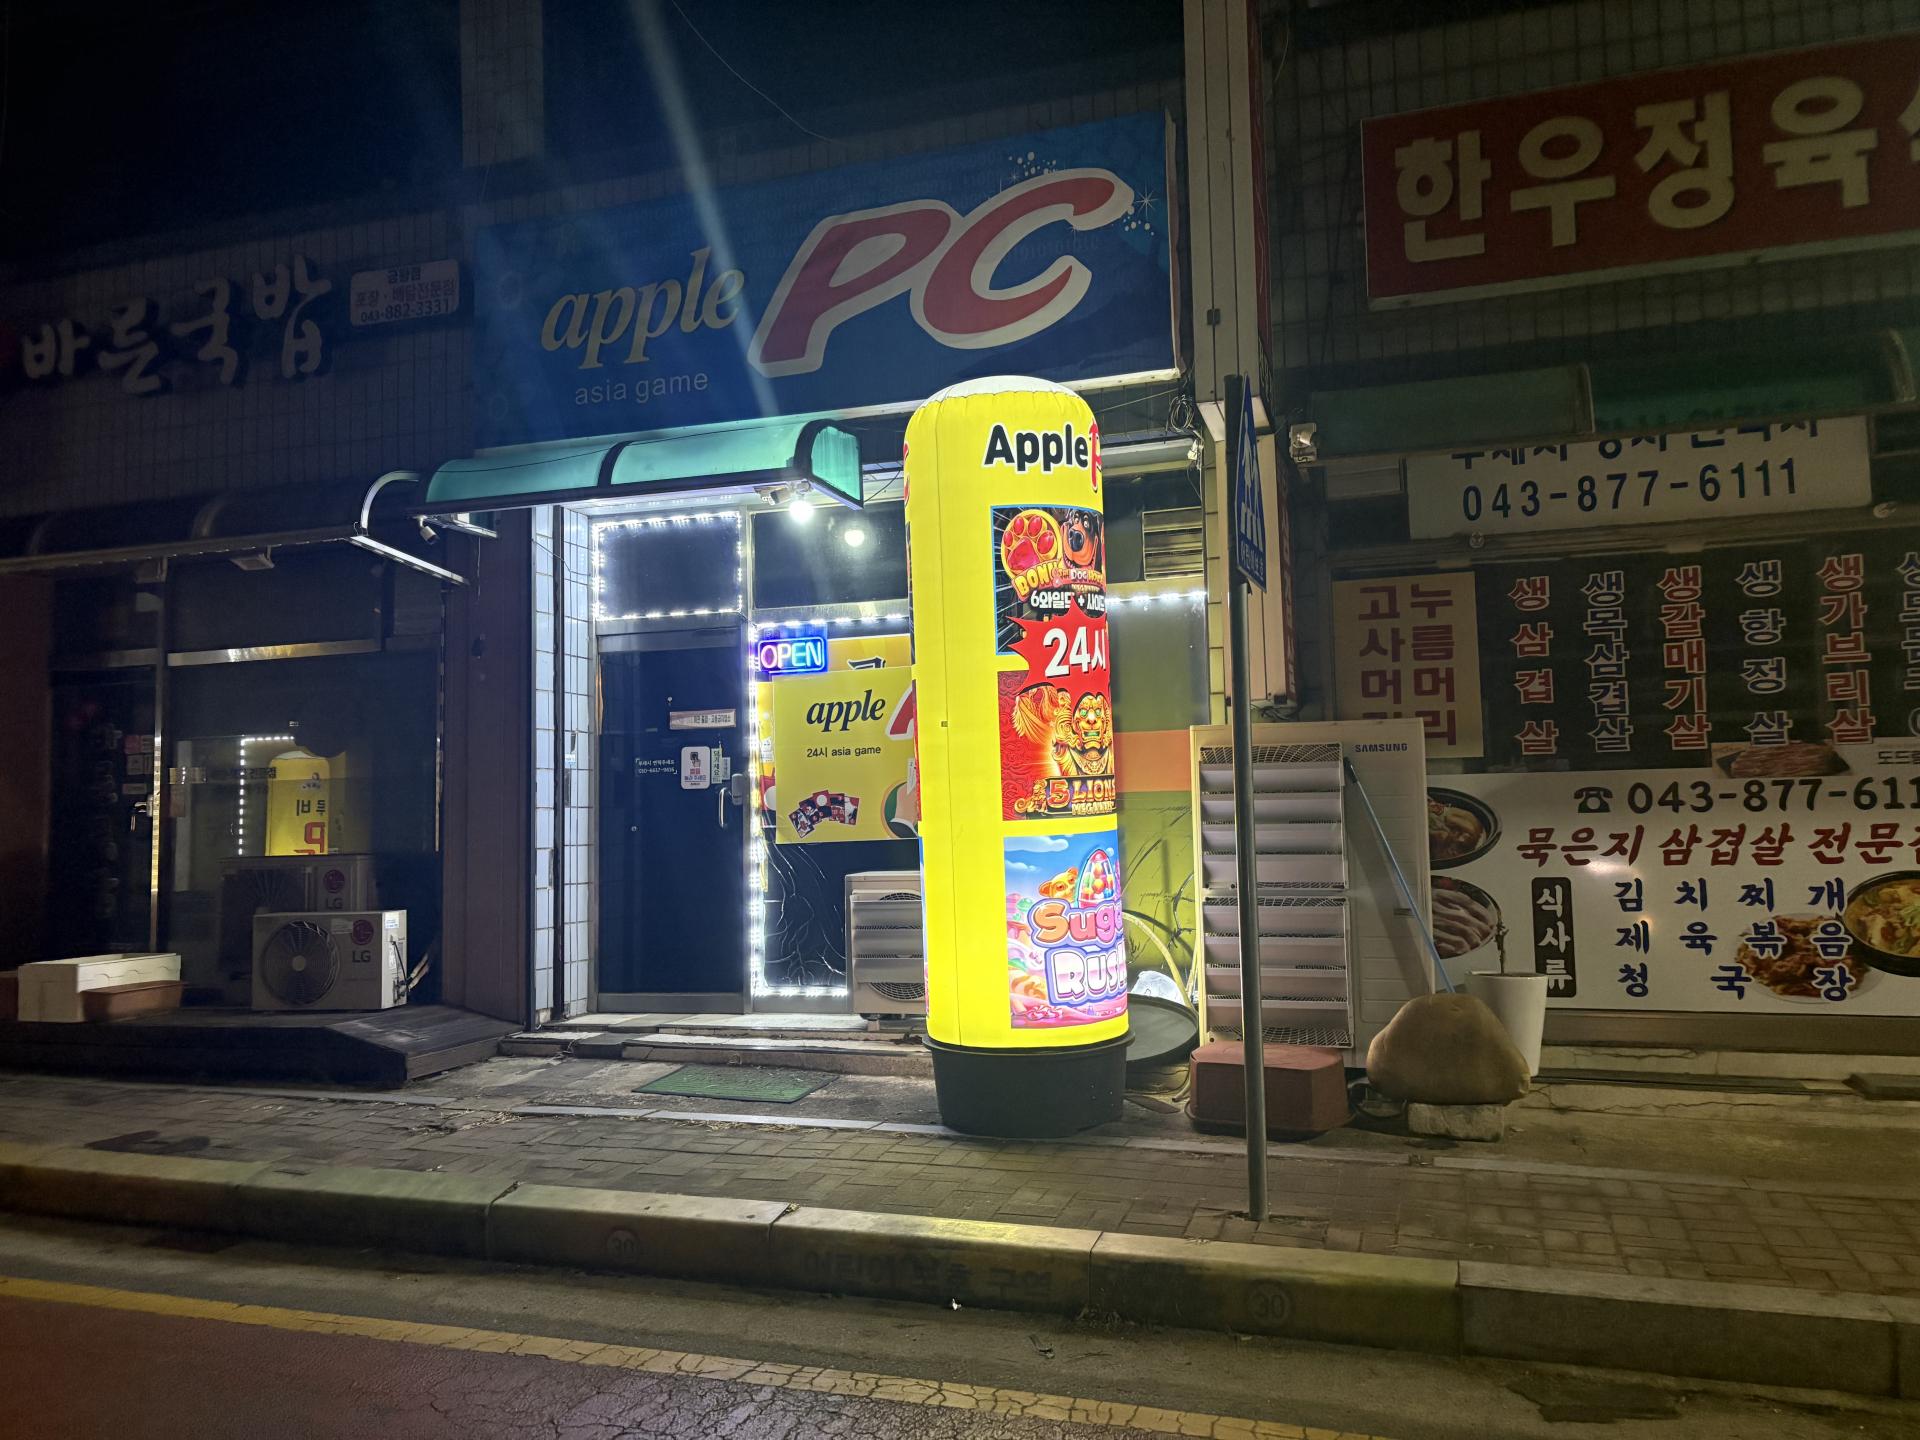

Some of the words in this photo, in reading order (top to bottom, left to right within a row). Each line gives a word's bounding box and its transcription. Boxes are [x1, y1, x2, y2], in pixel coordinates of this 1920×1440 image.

[541, 247, 745, 370] apple
[748, 167, 1135, 379] PC
[574, 378, 627, 407] asia
[635, 370, 709, 404] game
[984, 423, 1089, 472] Apple
[1462, 457, 1797, 522] 043-877-6111
[760, 641, 823, 670] OPEN
[1507, 576, 1560, 756] 생삼겹살
[1580, 571, 1636, 753] 생목삼겹살
[1657, 565, 1713, 751] 생갈매기살
[1735, 560, 1793, 747] 생항정살
[1816, 553, 1877, 746] 생가브리살
[806, 688, 886, 733] apple
[806, 747, 828, 758] 24시
[831, 746, 851, 757] asia
[854, 746, 881, 757] game
[1354, 743, 1408, 753] SAMSUNG
[1047, 779, 1071, 809] 5
[1517, 825, 1645, 867] 묵은지
[1658, 823, 1795, 866] 삼겹살
[352, 950, 372, 963] LG
[1536, 884, 1574, 991] 식사류
